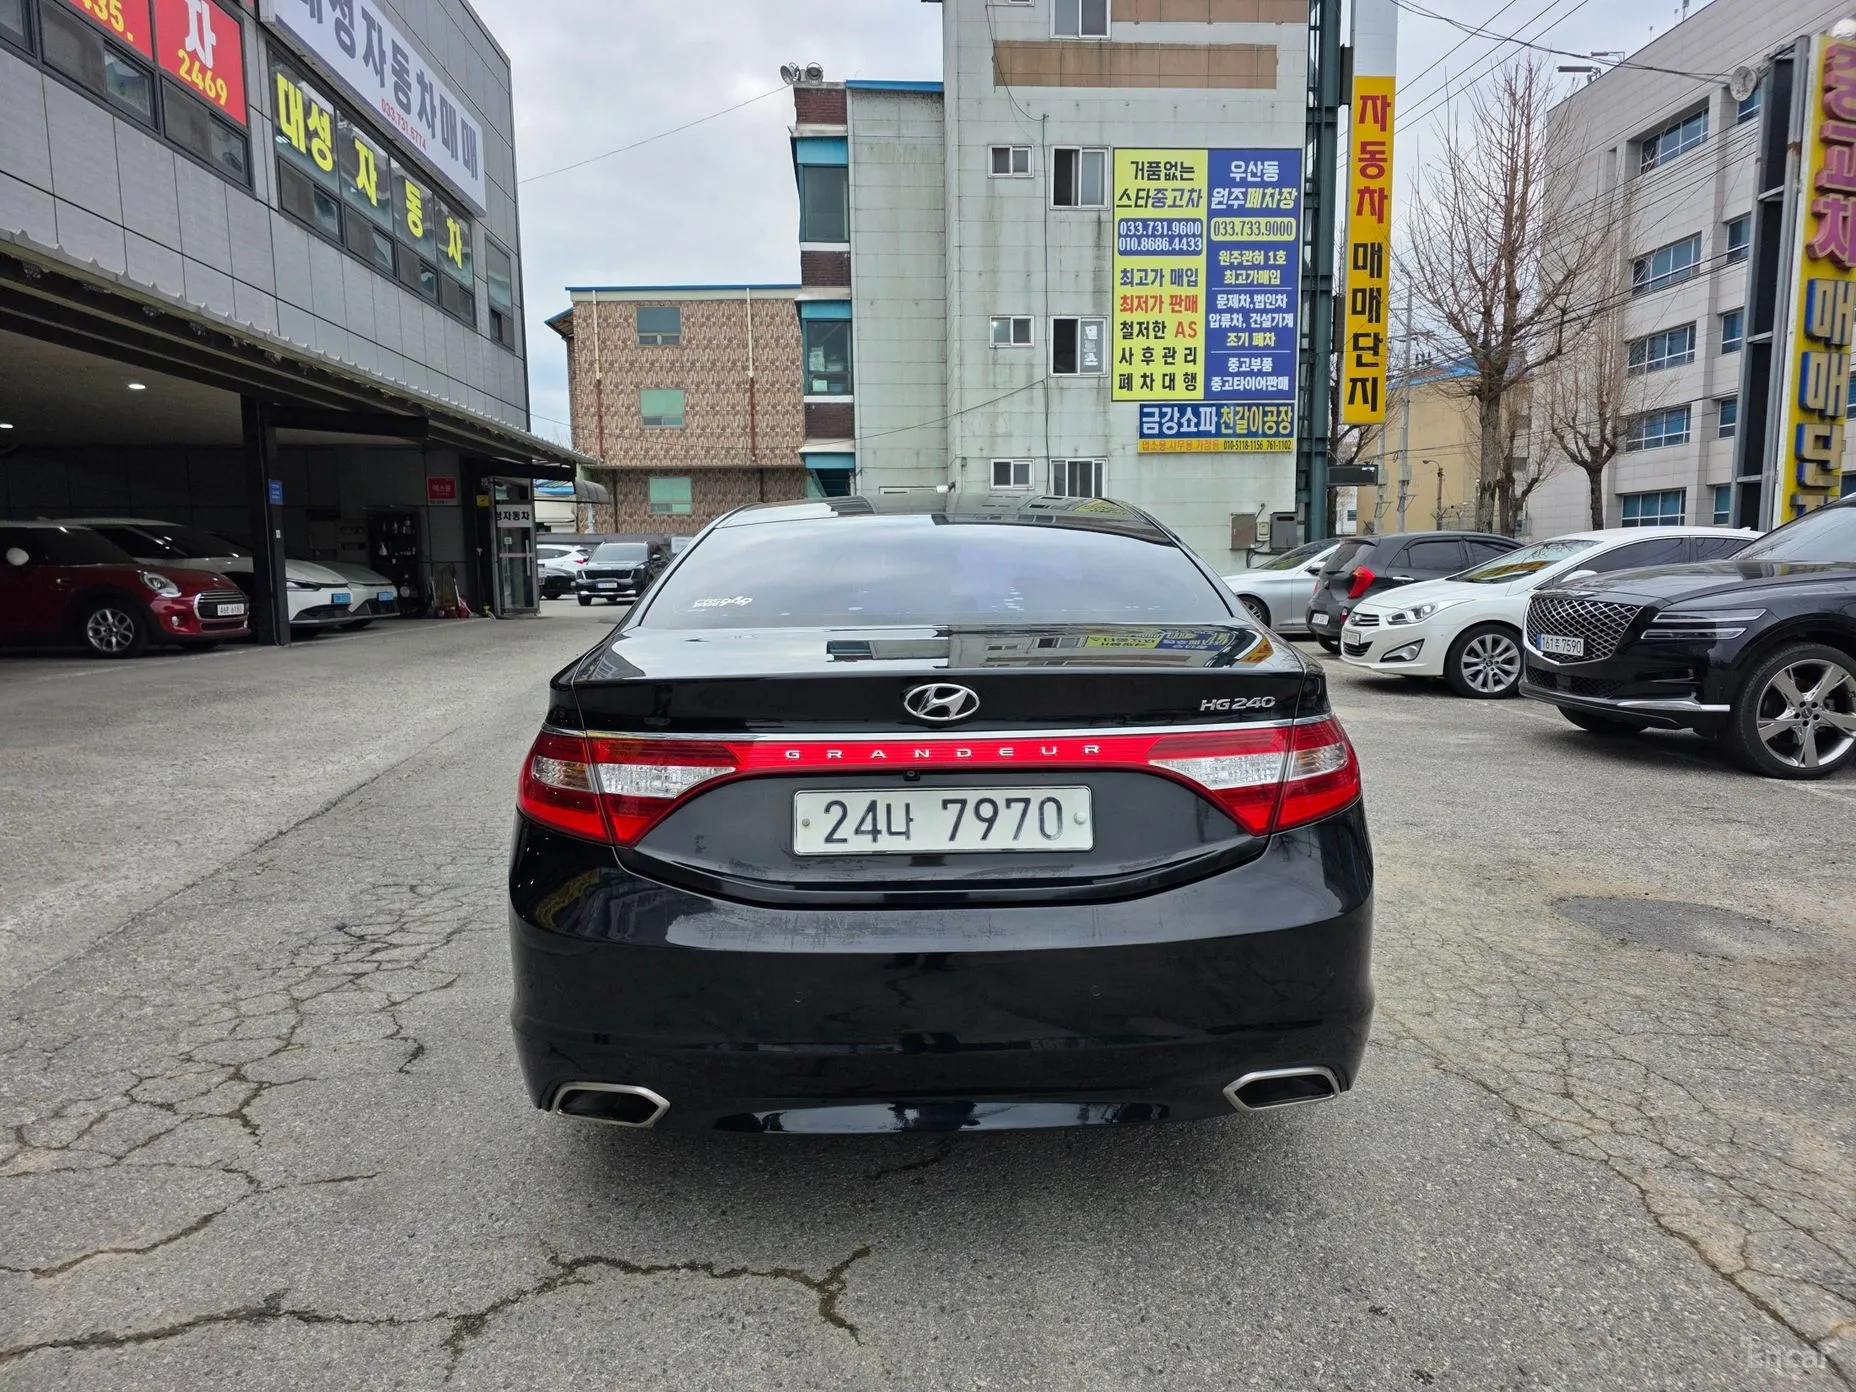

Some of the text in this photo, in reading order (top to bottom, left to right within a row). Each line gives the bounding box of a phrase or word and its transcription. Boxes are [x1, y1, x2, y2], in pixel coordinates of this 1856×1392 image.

[178, 49, 227, 106] 2469
[276, 72, 334, 172] 대성
[1355, 93, 1392, 225] 자동차
[1130, 160, 1196, 182] 거품없는
[1229, 160, 1280, 182] 우산동
[1115, 187, 1203, 209] 스타중고차
[1210, 187, 1298, 209] 원주폐차장
[1119, 220, 1202, 236] 033.731.9600
[1213, 220, 1293, 237] 033.733.9000
[1118, 236, 1202, 252] 010.8686.4433
[1218, 250, 1287, 266] 원주관허 1호
[1119, 267, 1200, 288] 최고가 매입
[1223, 269, 1280, 285] 최고가매입
[1119, 294, 1199, 314] 최저가 판매
[1119, 320, 1198, 340] 철저한 AS
[1249, 313, 1294, 328] 건설기계
[1347, 241, 1385, 413] 매매단지
[1226, 332, 1276, 347] 조기 폐차
[1227, 357, 1274, 372] 중고부품
[1210, 376, 1289, 392] 중고타이어판매
[1142, 406, 1293, 435] 금강쇼파 천갈이공장
[1223, 439, 1264, 450] 010-5118-1156
[1266, 439, 1292, 450] 761-1102
[1561, 638, 1582, 653] 7590
[785, 743, 1101, 760] GRANDEUR
[823, 795, 1064, 844] 24나 7970
